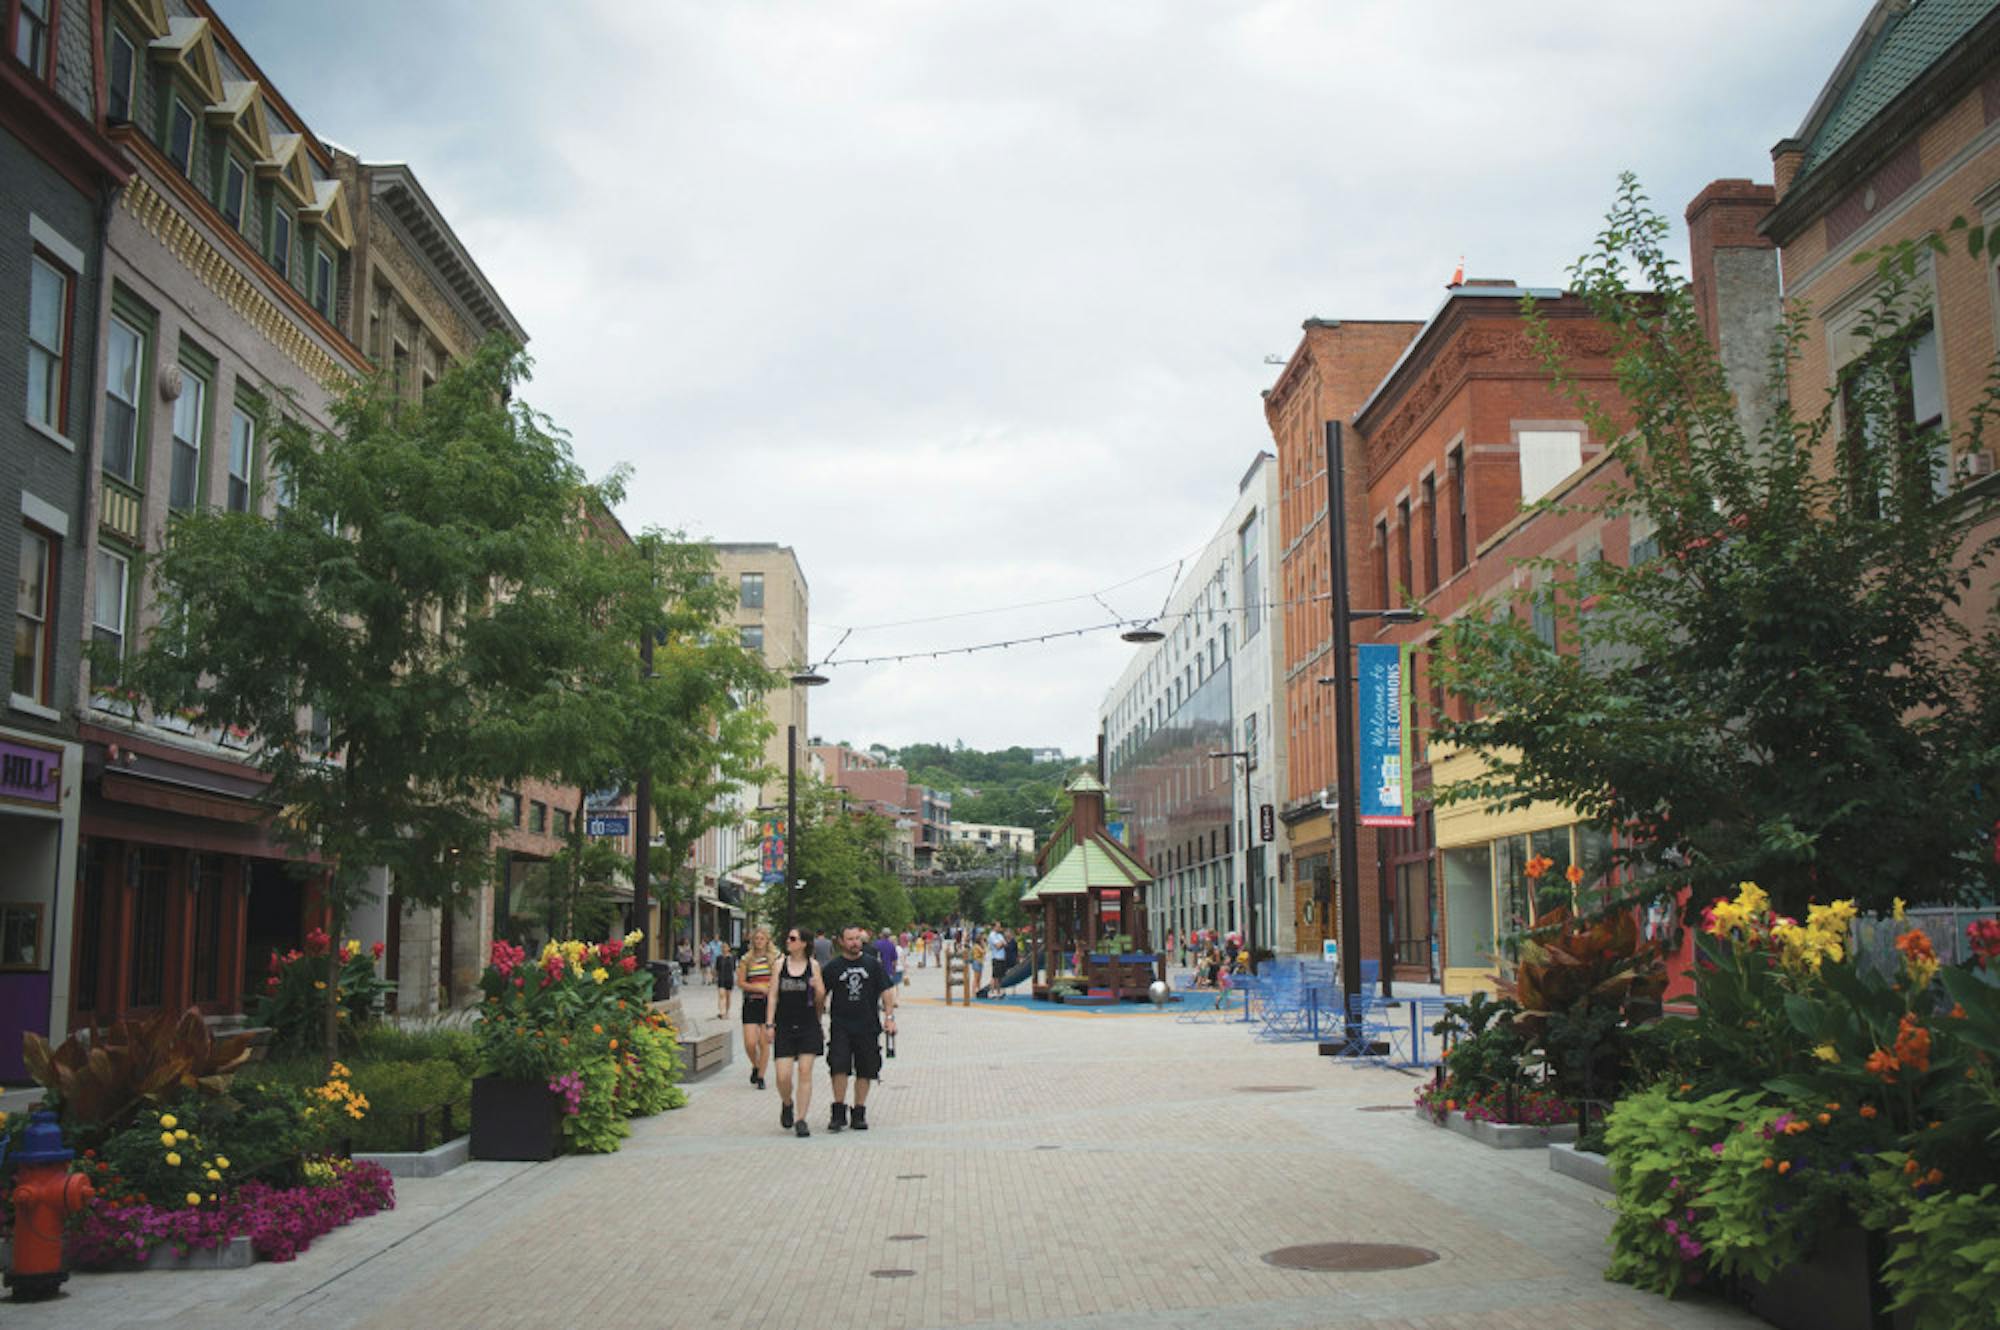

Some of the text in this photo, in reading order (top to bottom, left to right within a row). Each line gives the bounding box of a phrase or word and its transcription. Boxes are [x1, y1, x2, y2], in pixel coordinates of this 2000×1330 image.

[1369, 663, 1385, 747] Welcome to
[1387, 663, 1400, 747] THE COMMONS
